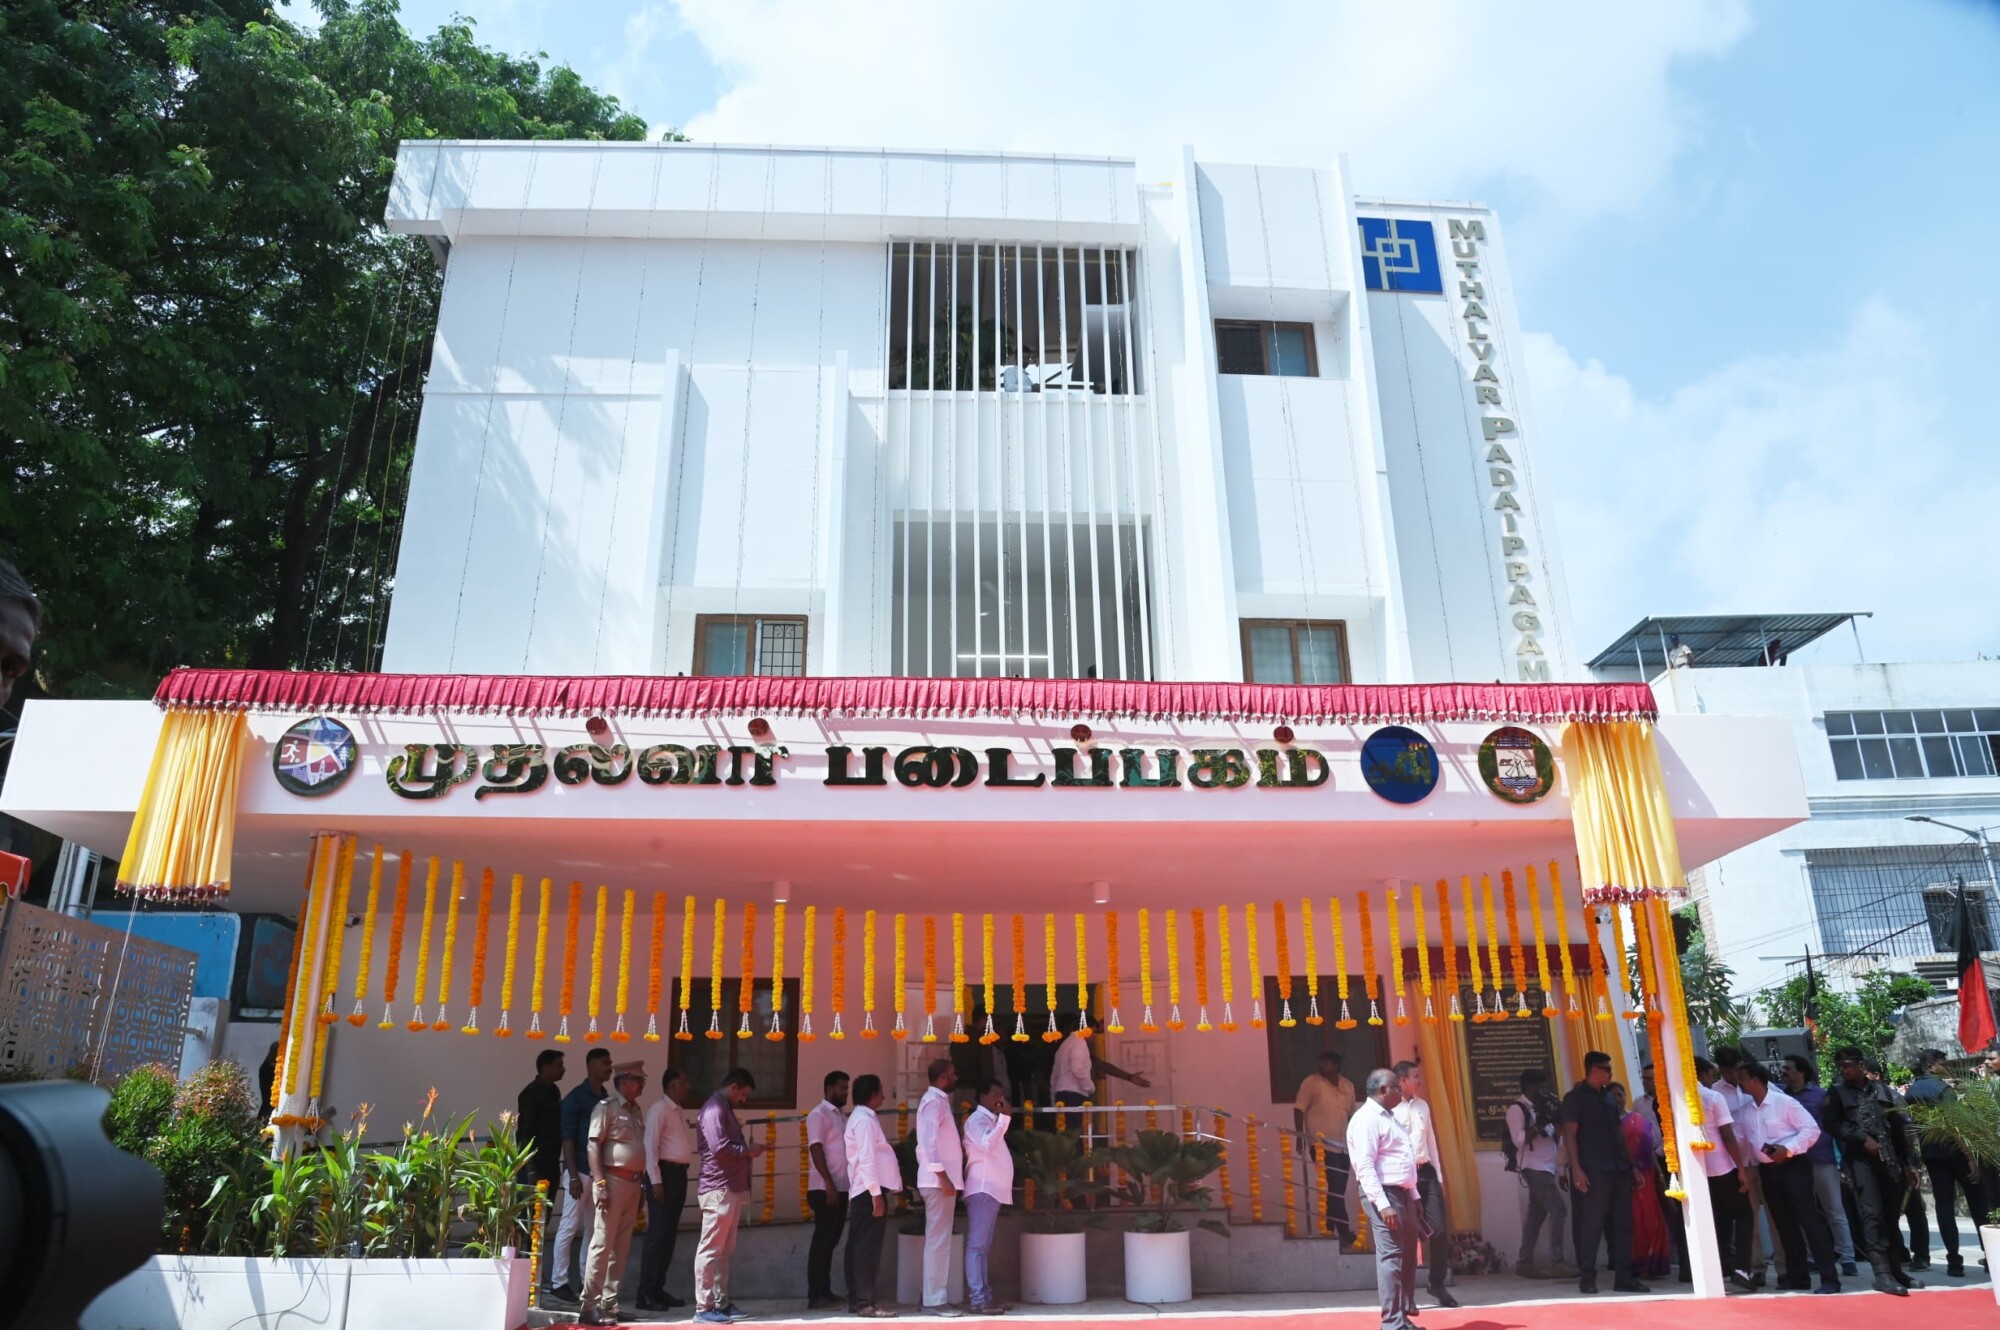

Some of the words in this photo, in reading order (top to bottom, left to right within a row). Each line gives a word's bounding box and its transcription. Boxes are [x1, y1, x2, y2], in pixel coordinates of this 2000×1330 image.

[1448, 219, 1501, 404] MUTHALVAR
[1481, 417, 1549, 681] PADAIPPAGAM
[386, 717, 789, 799] முதல்வர்
[823, 724, 1329, 788] படைப்பகம்
